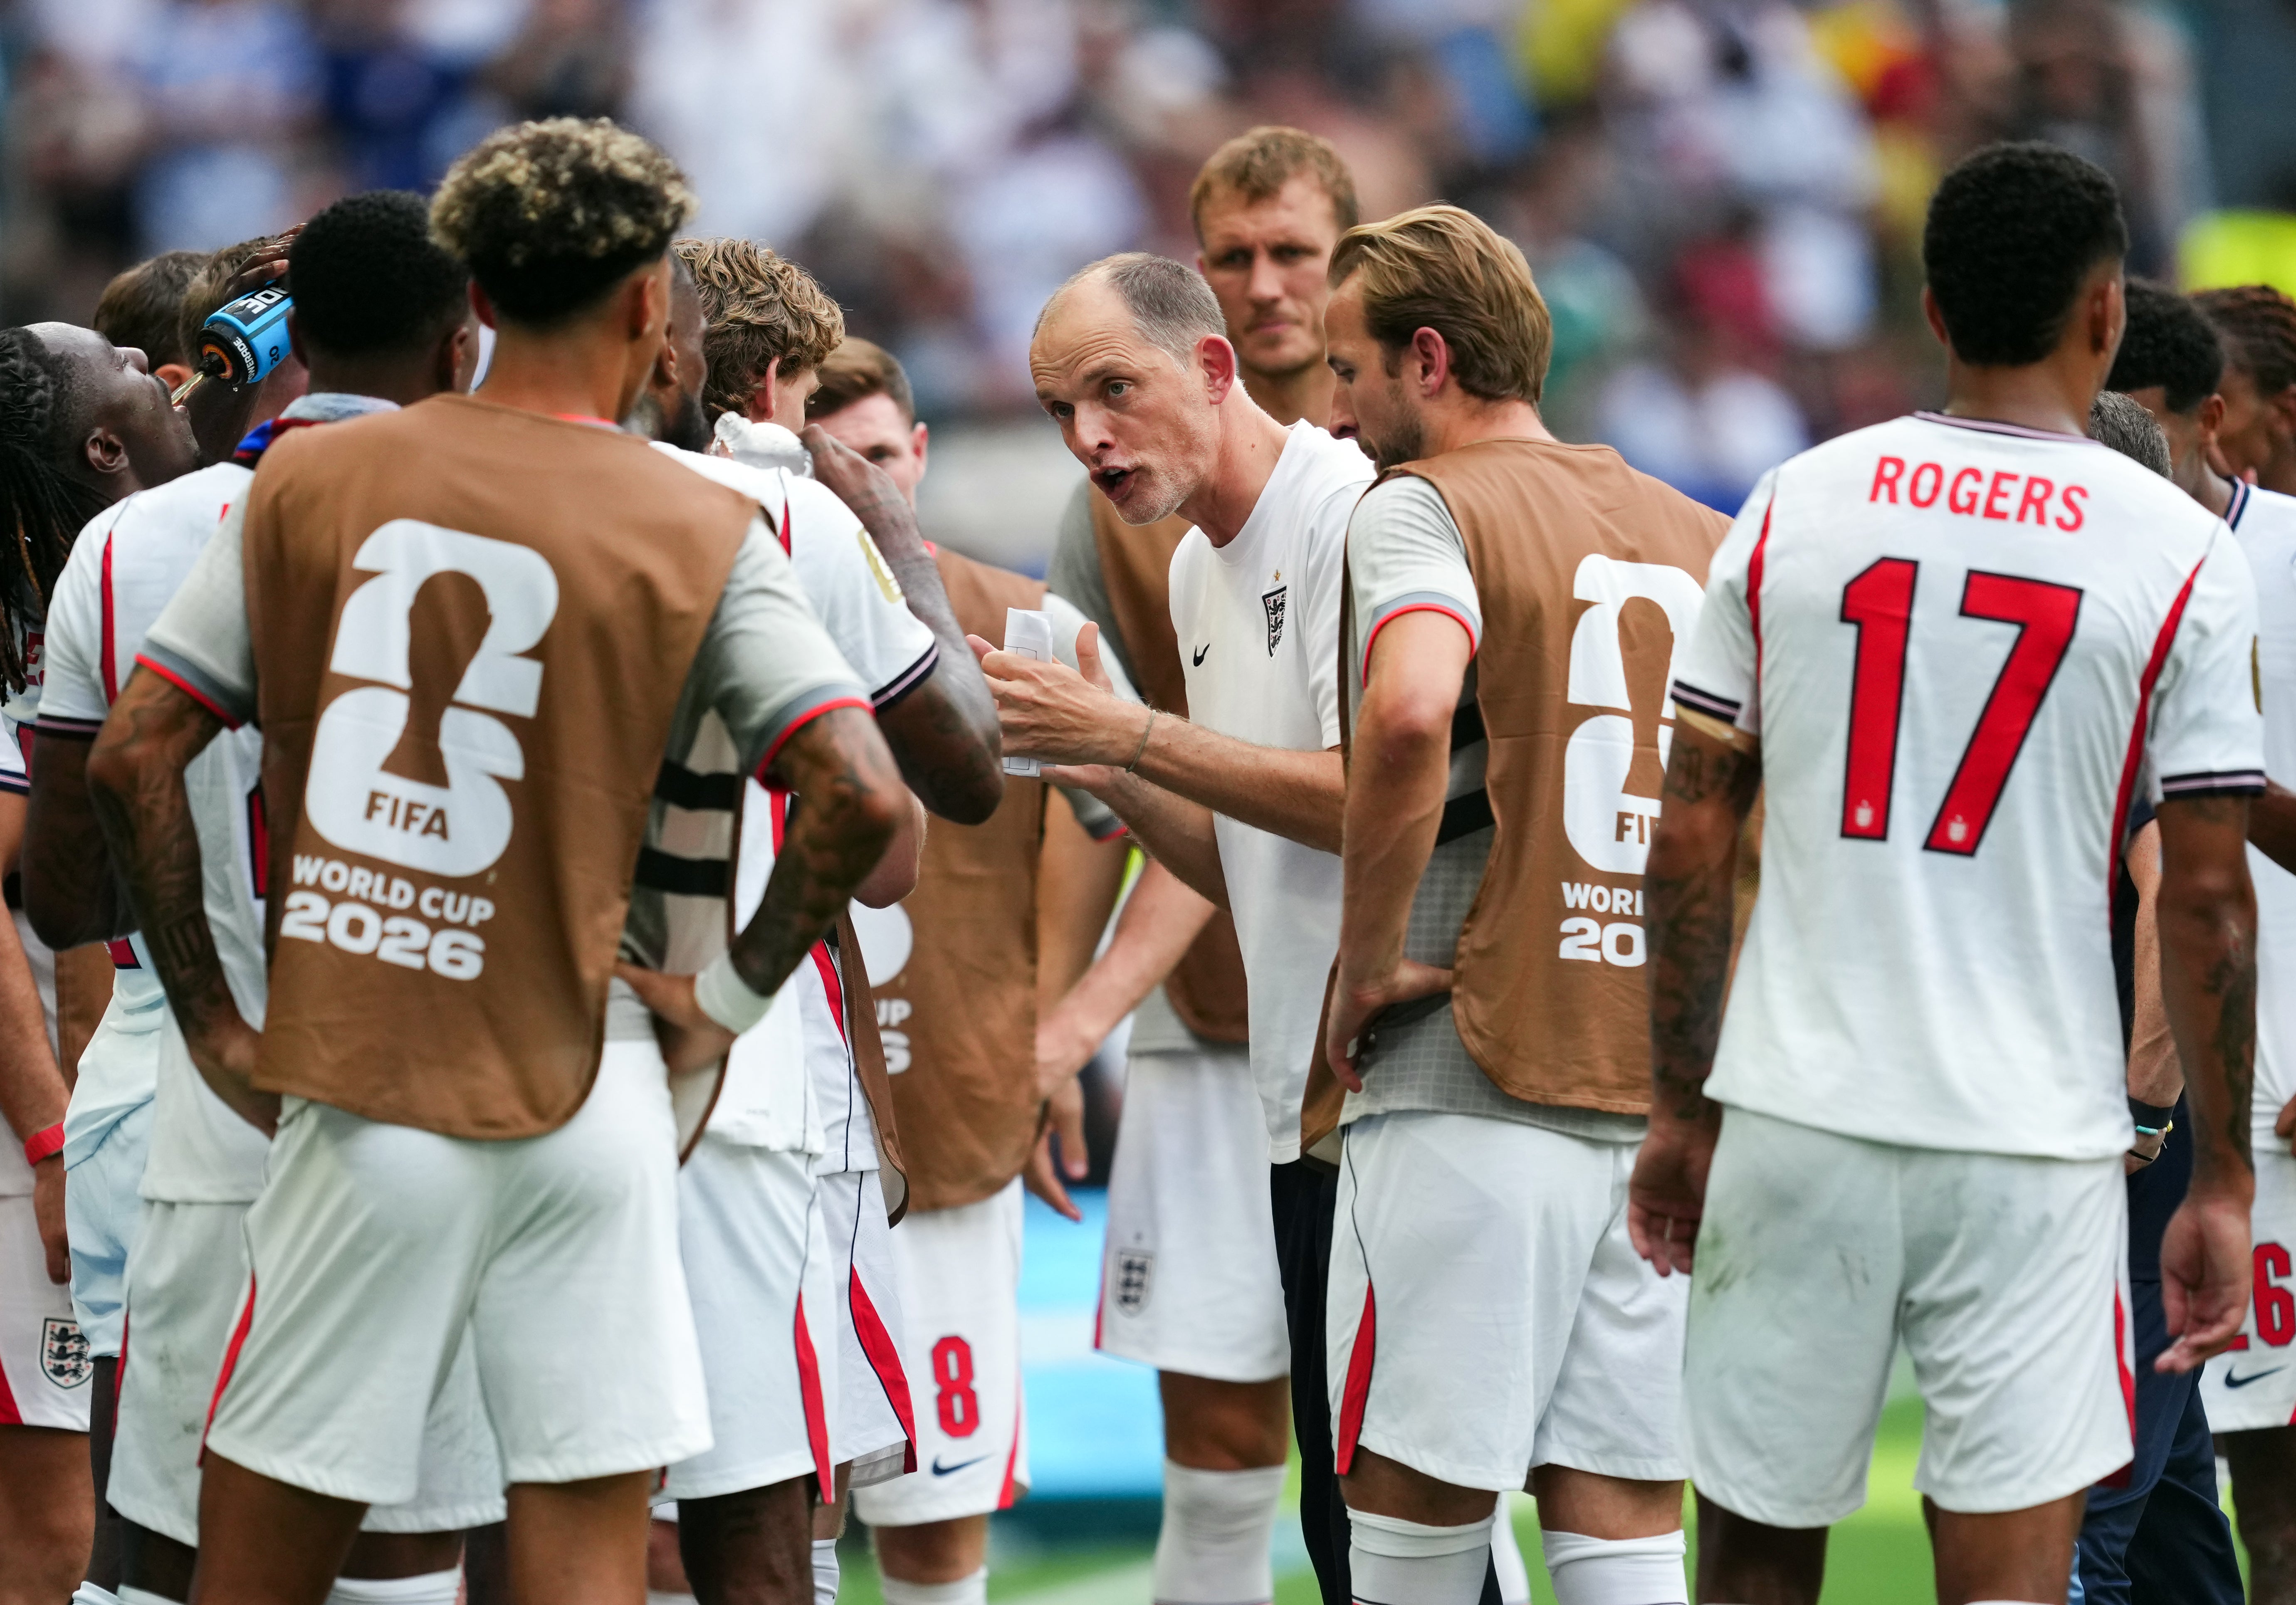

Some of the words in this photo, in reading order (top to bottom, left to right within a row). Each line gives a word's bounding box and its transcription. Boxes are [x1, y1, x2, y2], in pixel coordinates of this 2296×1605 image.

[233, 337, 255, 380] OWERADE
[1869, 455, 2089, 532] ROGERS
[1840, 556, 2084, 857] 17
[363, 790, 450, 842] FIFA
[292, 854, 415, 911] WORLD
[419, 886, 496, 928] CUP
[280, 890, 486, 981] 2026
[1559, 916, 1647, 967] 20
[932, 1336, 980, 1439] 8
